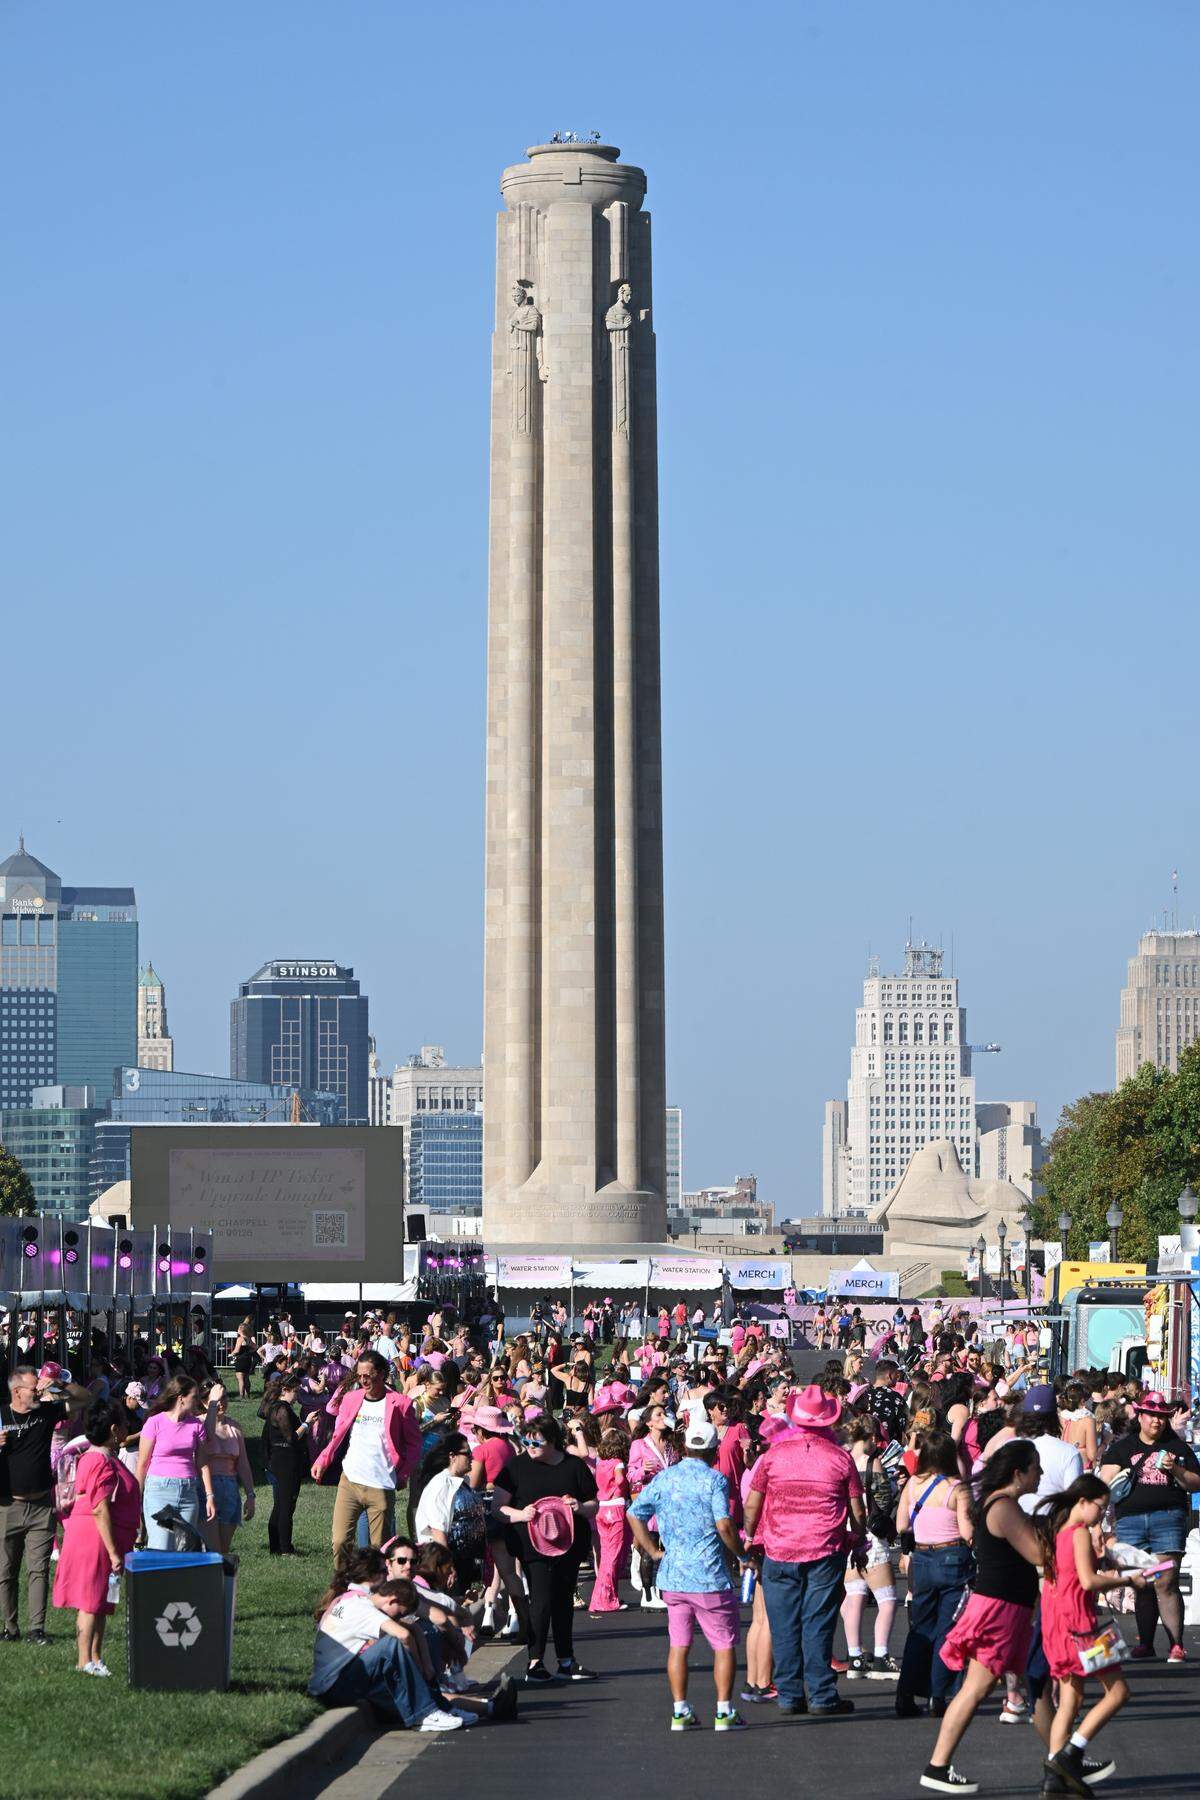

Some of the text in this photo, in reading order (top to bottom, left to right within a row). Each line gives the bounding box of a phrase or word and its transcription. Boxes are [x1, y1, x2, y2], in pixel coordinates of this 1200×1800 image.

[12, 898, 33, 907] Bank
[12, 906, 45, 914] Midwest
[280, 967, 337, 976] STINSON
[126, 1070, 140, 1092] 3
[738, 1270, 776, 1279] MERCH
[845, 1279, 883, 1289] MERCH
[66, 1331, 83, 1339] STAFF
